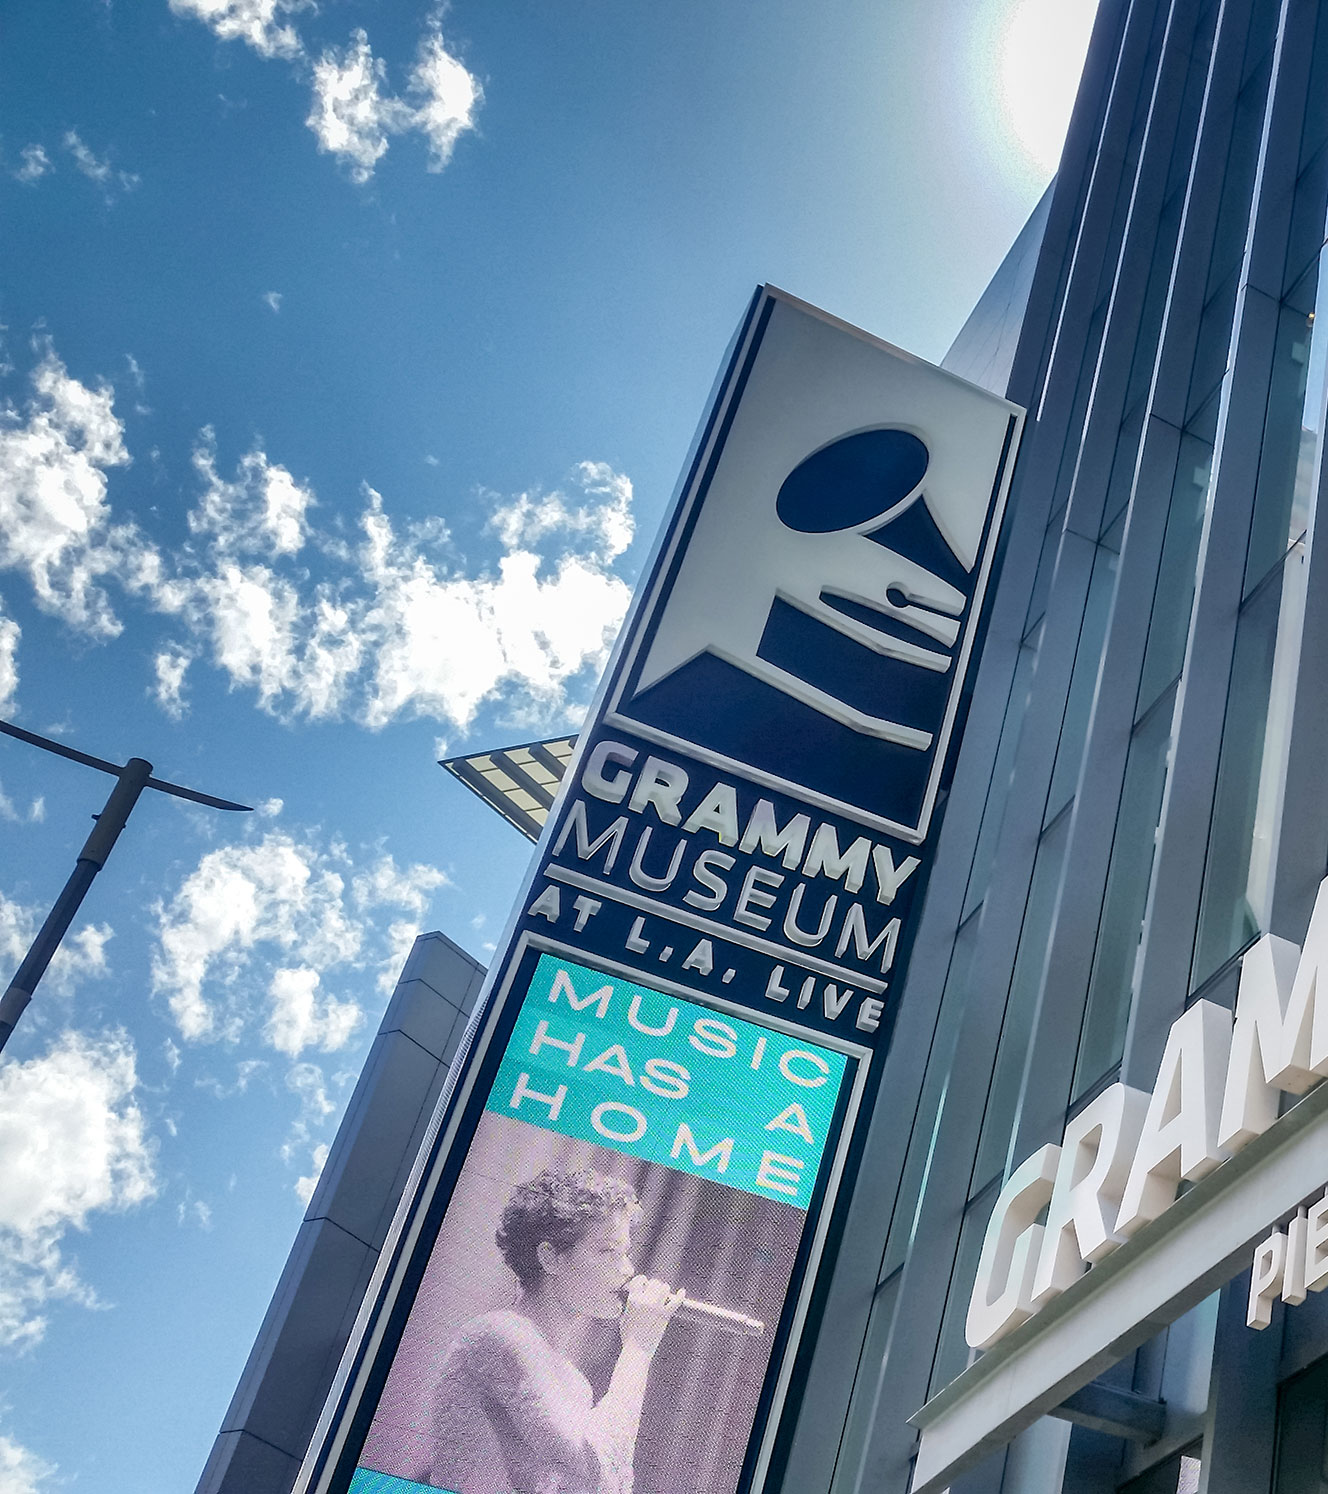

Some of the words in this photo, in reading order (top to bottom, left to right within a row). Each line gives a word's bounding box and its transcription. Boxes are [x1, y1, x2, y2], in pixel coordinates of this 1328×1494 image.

[552, 800, 901, 974] MUSEUM
[581, 740, 921, 906] GRAMMY
[528, 884, 602, 931] AT
[625, 916, 737, 983] L.A.
[765, 965, 885, 1033] LIVE
[528, 1021, 691, 1100] HAS
[764, 1102, 814, 1144] A
[548, 969, 829, 1088] MUSIC
[509, 1072, 805, 1196] HOME
